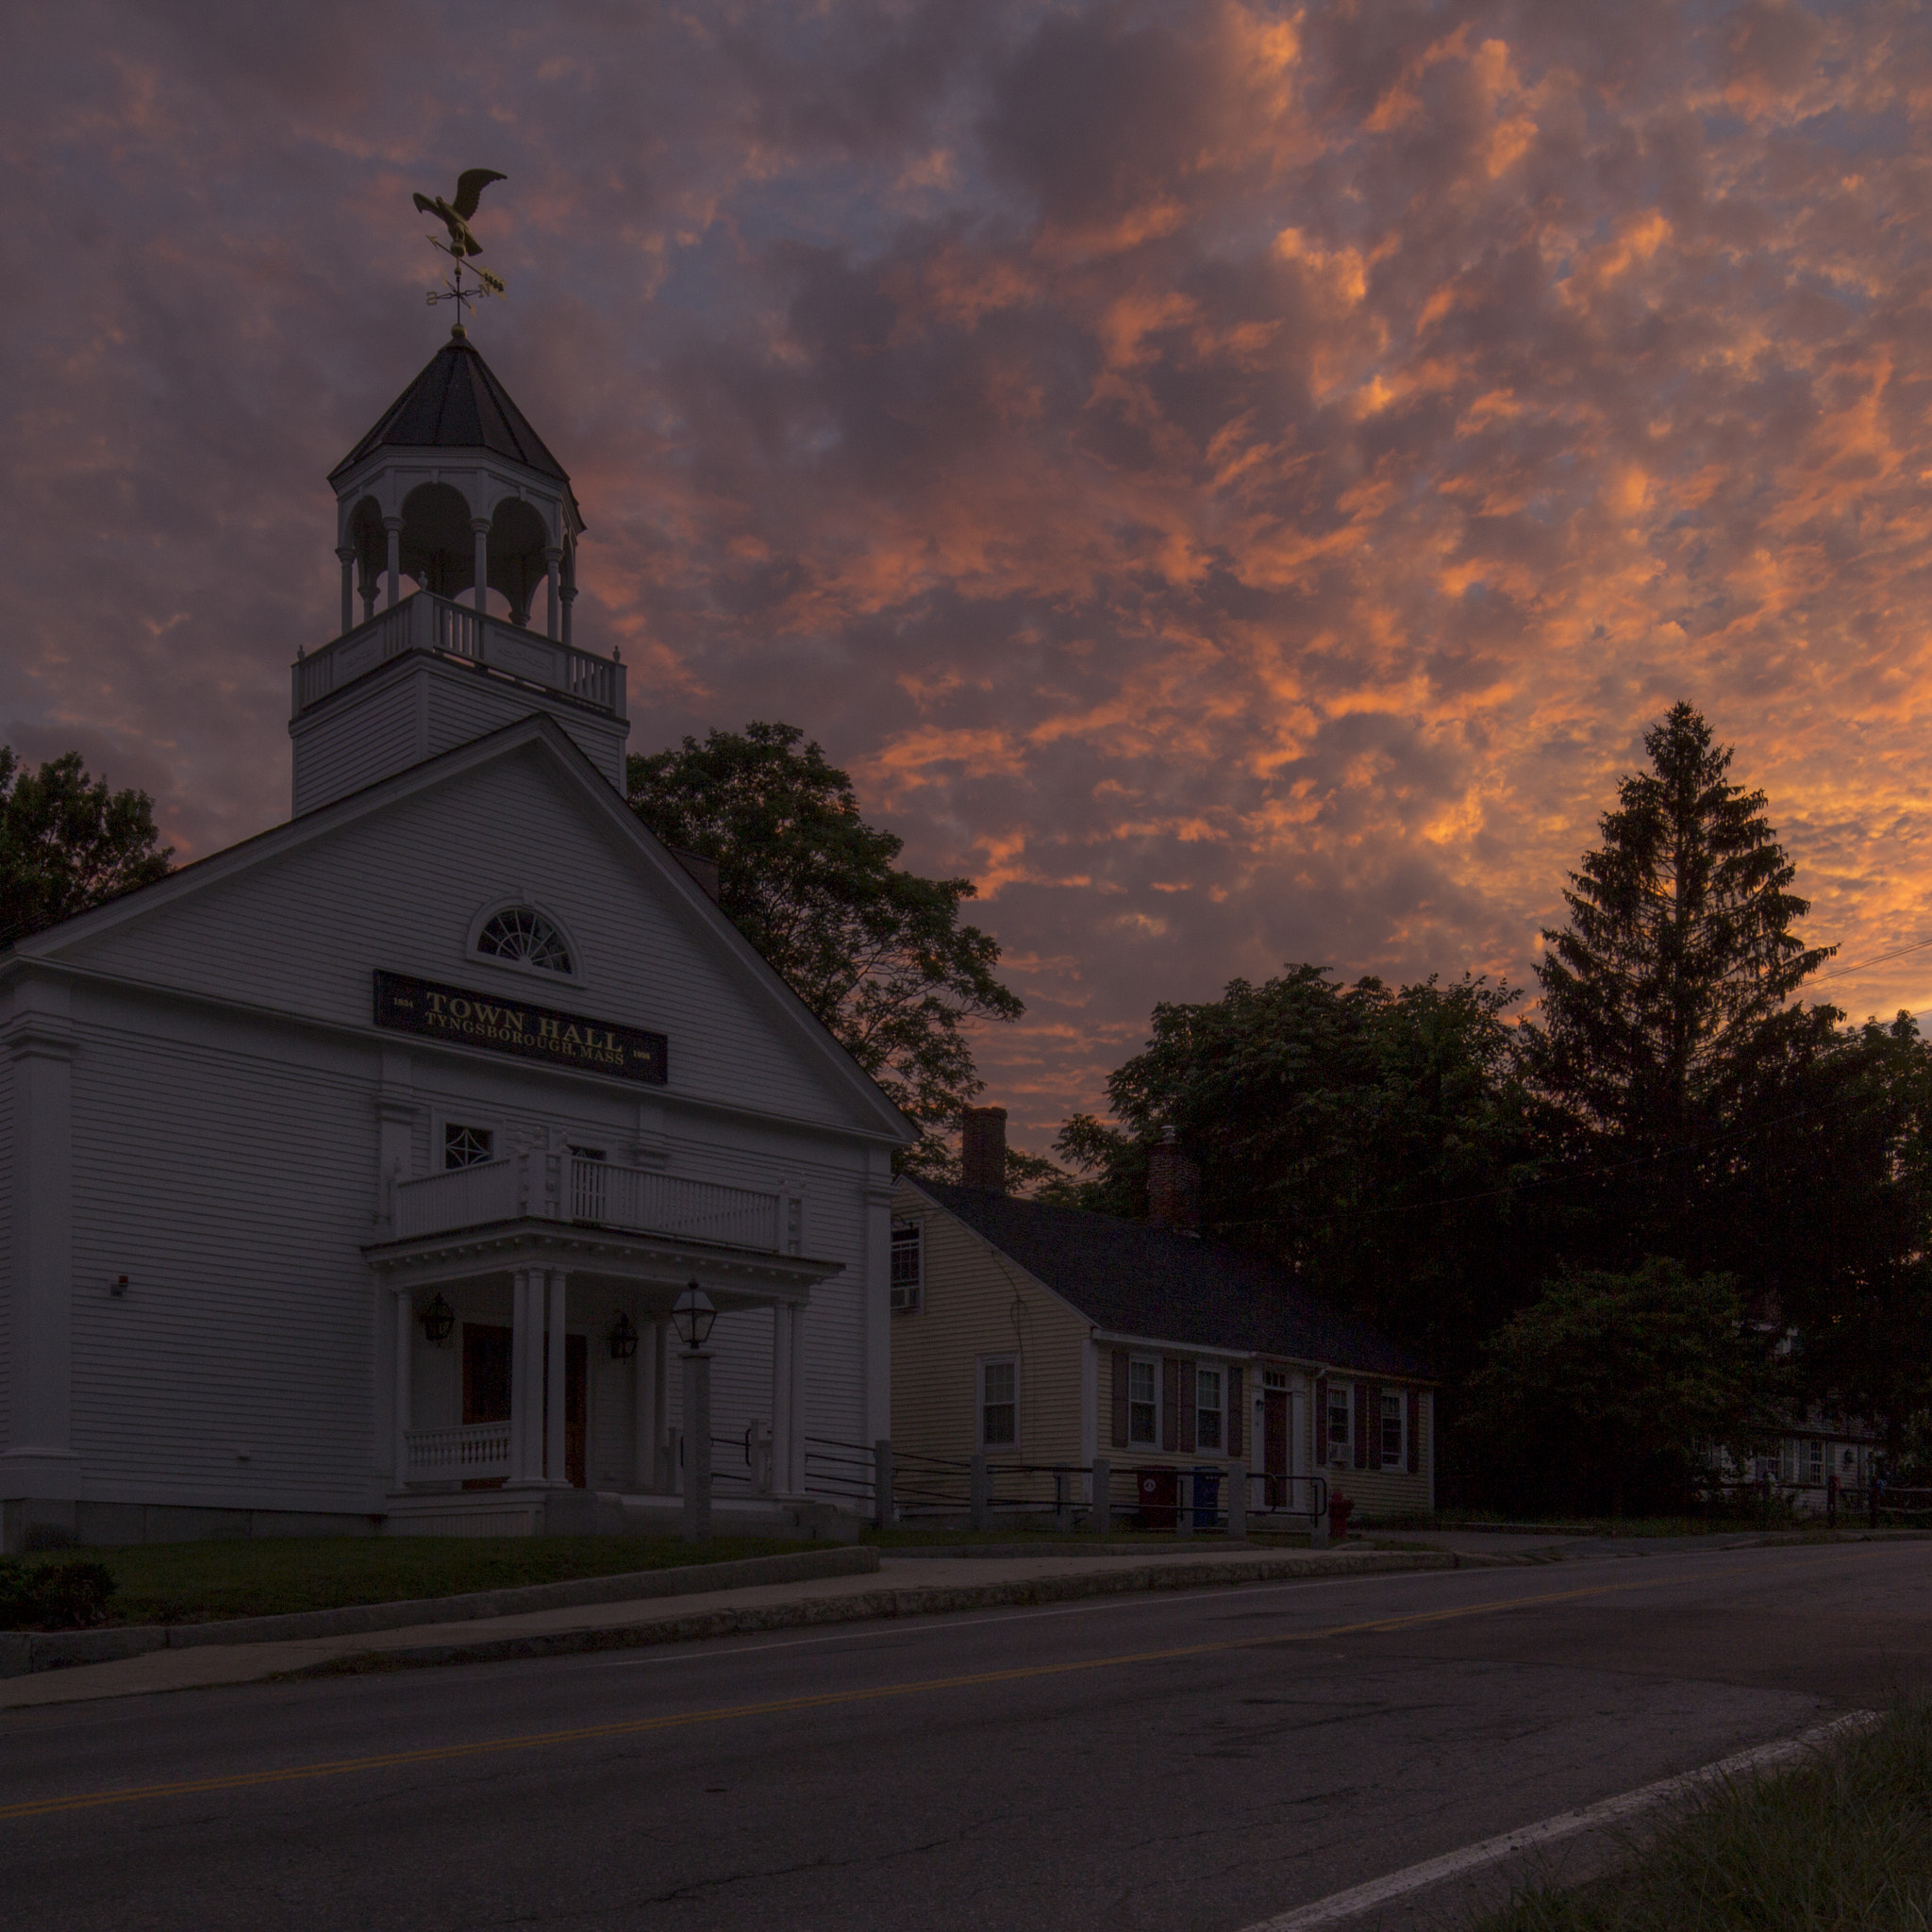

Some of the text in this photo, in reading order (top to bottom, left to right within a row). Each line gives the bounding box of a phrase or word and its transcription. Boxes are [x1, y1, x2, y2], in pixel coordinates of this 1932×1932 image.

[425, 1012, 625, 1065] TYNGSBOROUGH, MASS
[426, 991, 623, 1053] TOWN HALL
